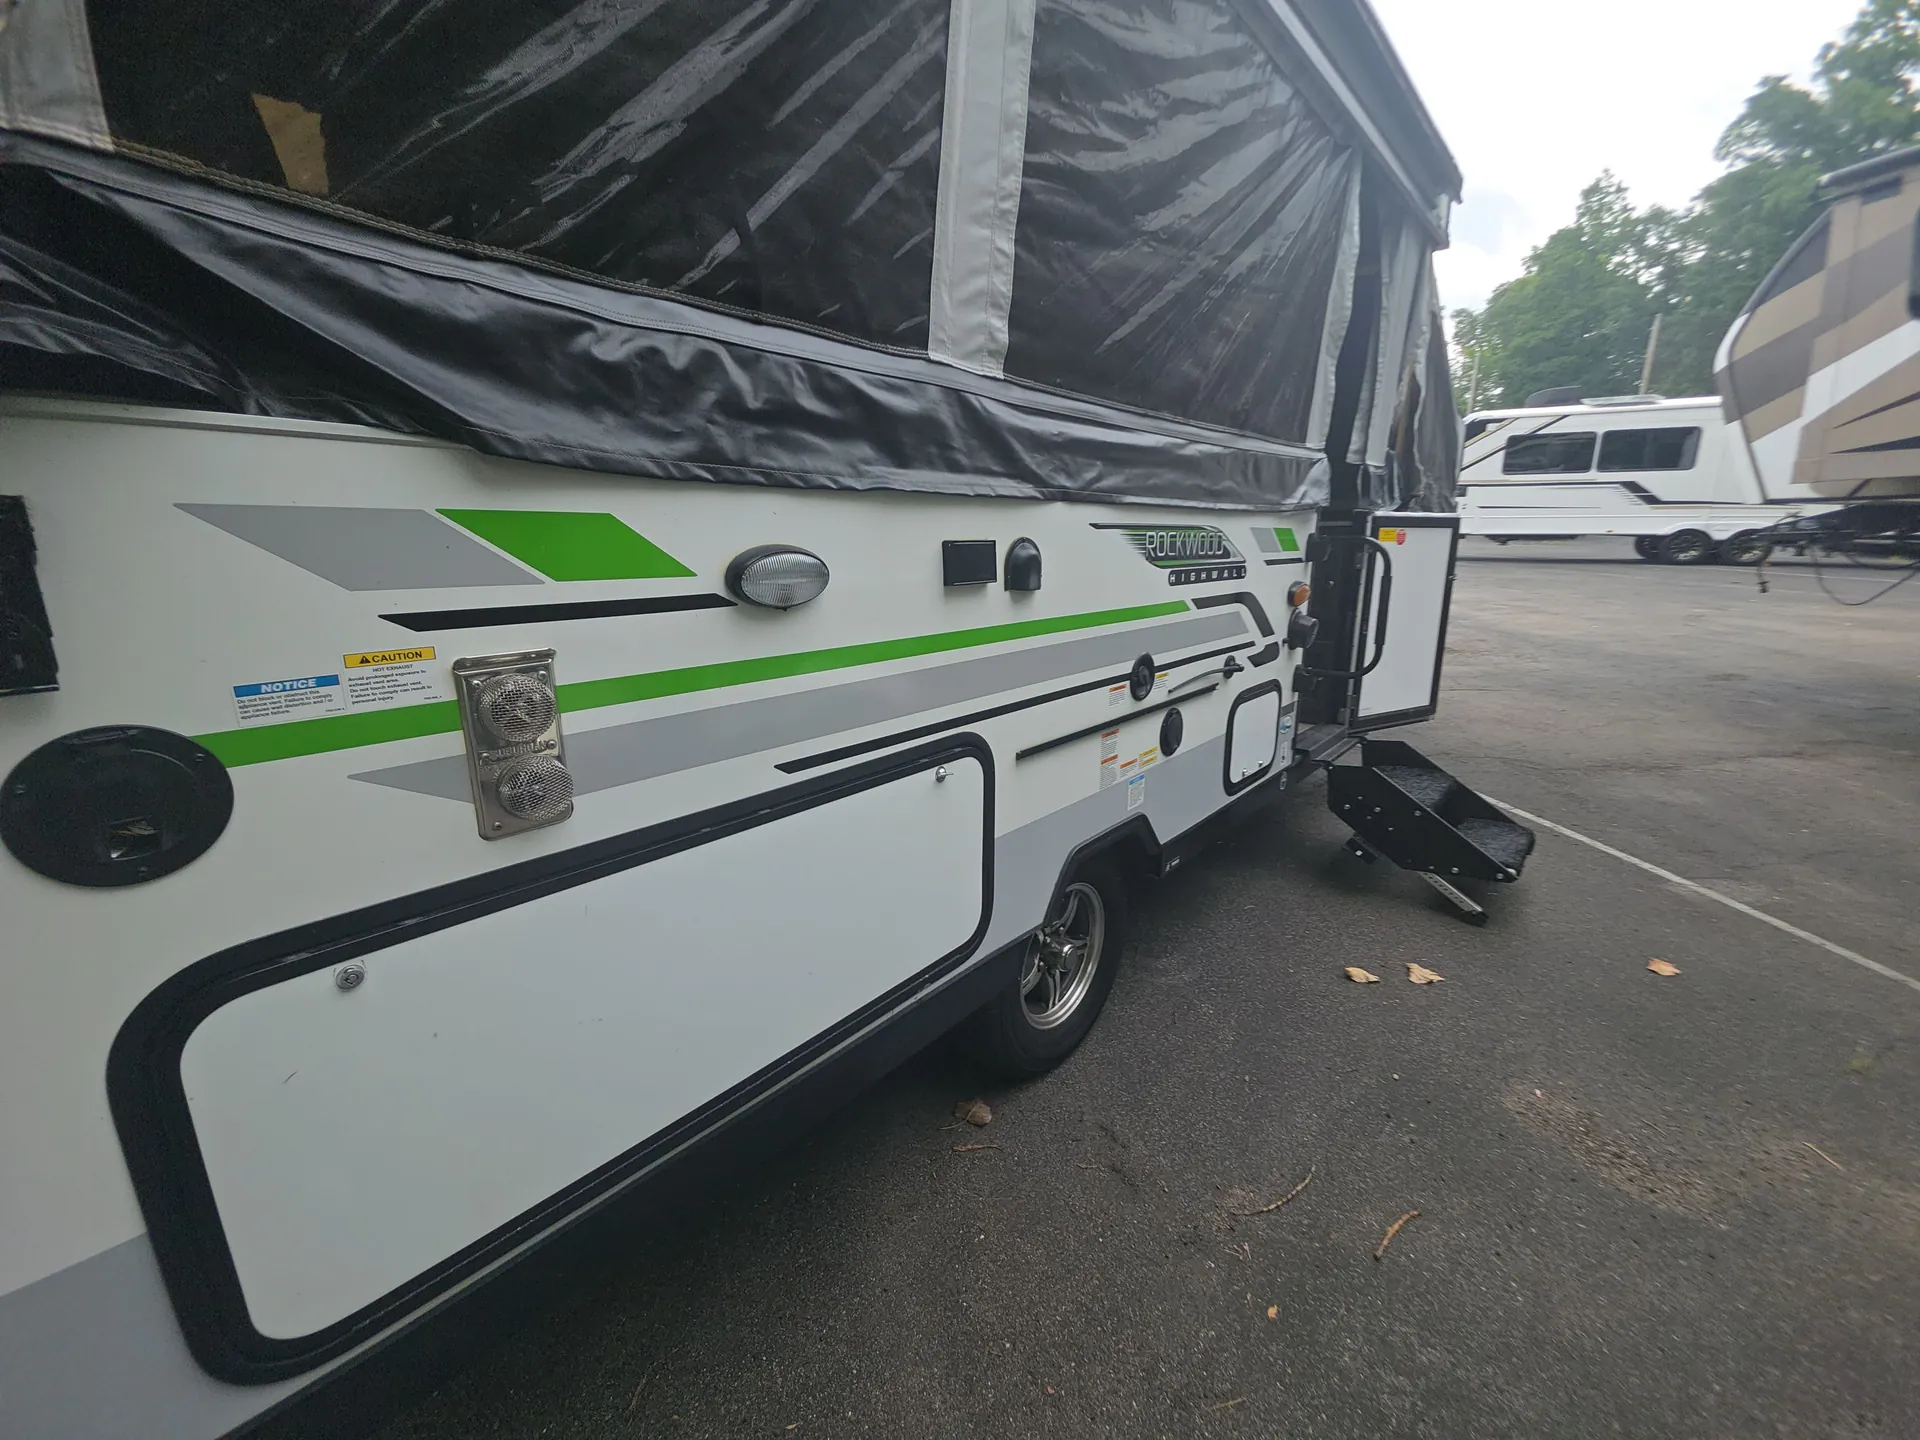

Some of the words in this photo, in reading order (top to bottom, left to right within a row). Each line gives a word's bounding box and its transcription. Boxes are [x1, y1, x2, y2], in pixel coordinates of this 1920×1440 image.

[1146, 532, 1224, 557] ROCKWOOD
[1170, 568, 1246, 583] HIGHWALL
[372, 651, 422, 663] CAUTION
[261, 679, 316, 693] NOTICE
